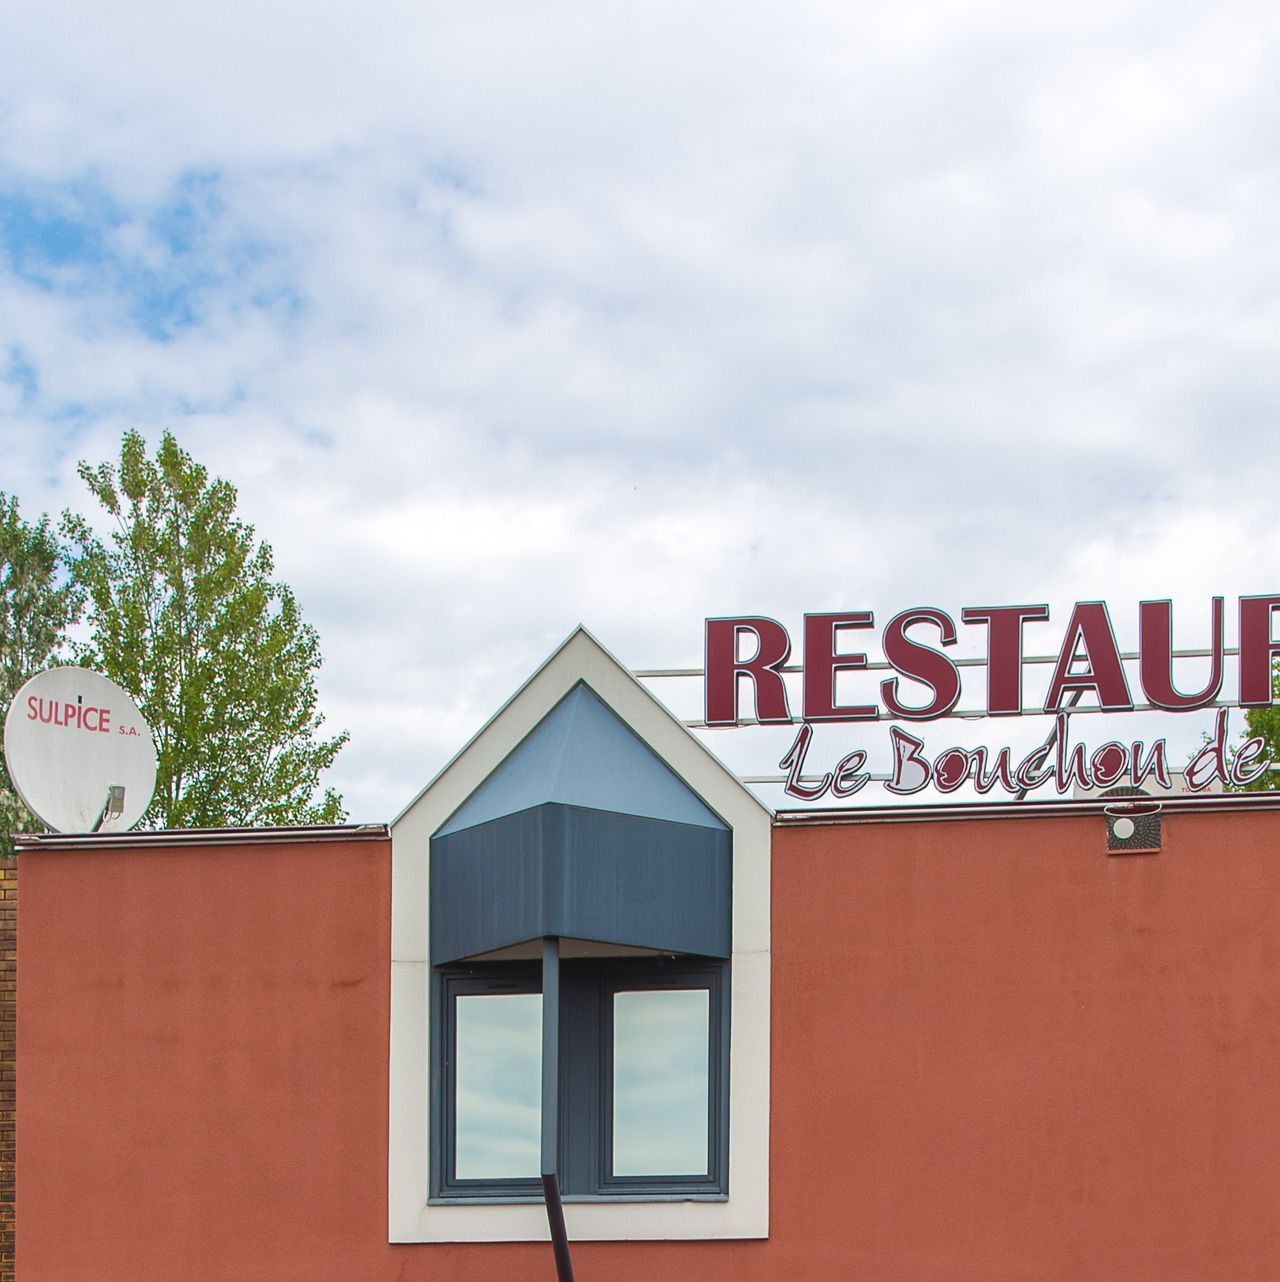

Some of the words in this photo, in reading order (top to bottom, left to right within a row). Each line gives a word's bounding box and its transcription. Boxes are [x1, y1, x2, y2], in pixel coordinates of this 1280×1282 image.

[118, 725, 141, 737] S.A.
[778, 722, 871, 801] Le
[883, 708, 1172, 796] Bouchon
[1183, 706, 1272, 793] de
